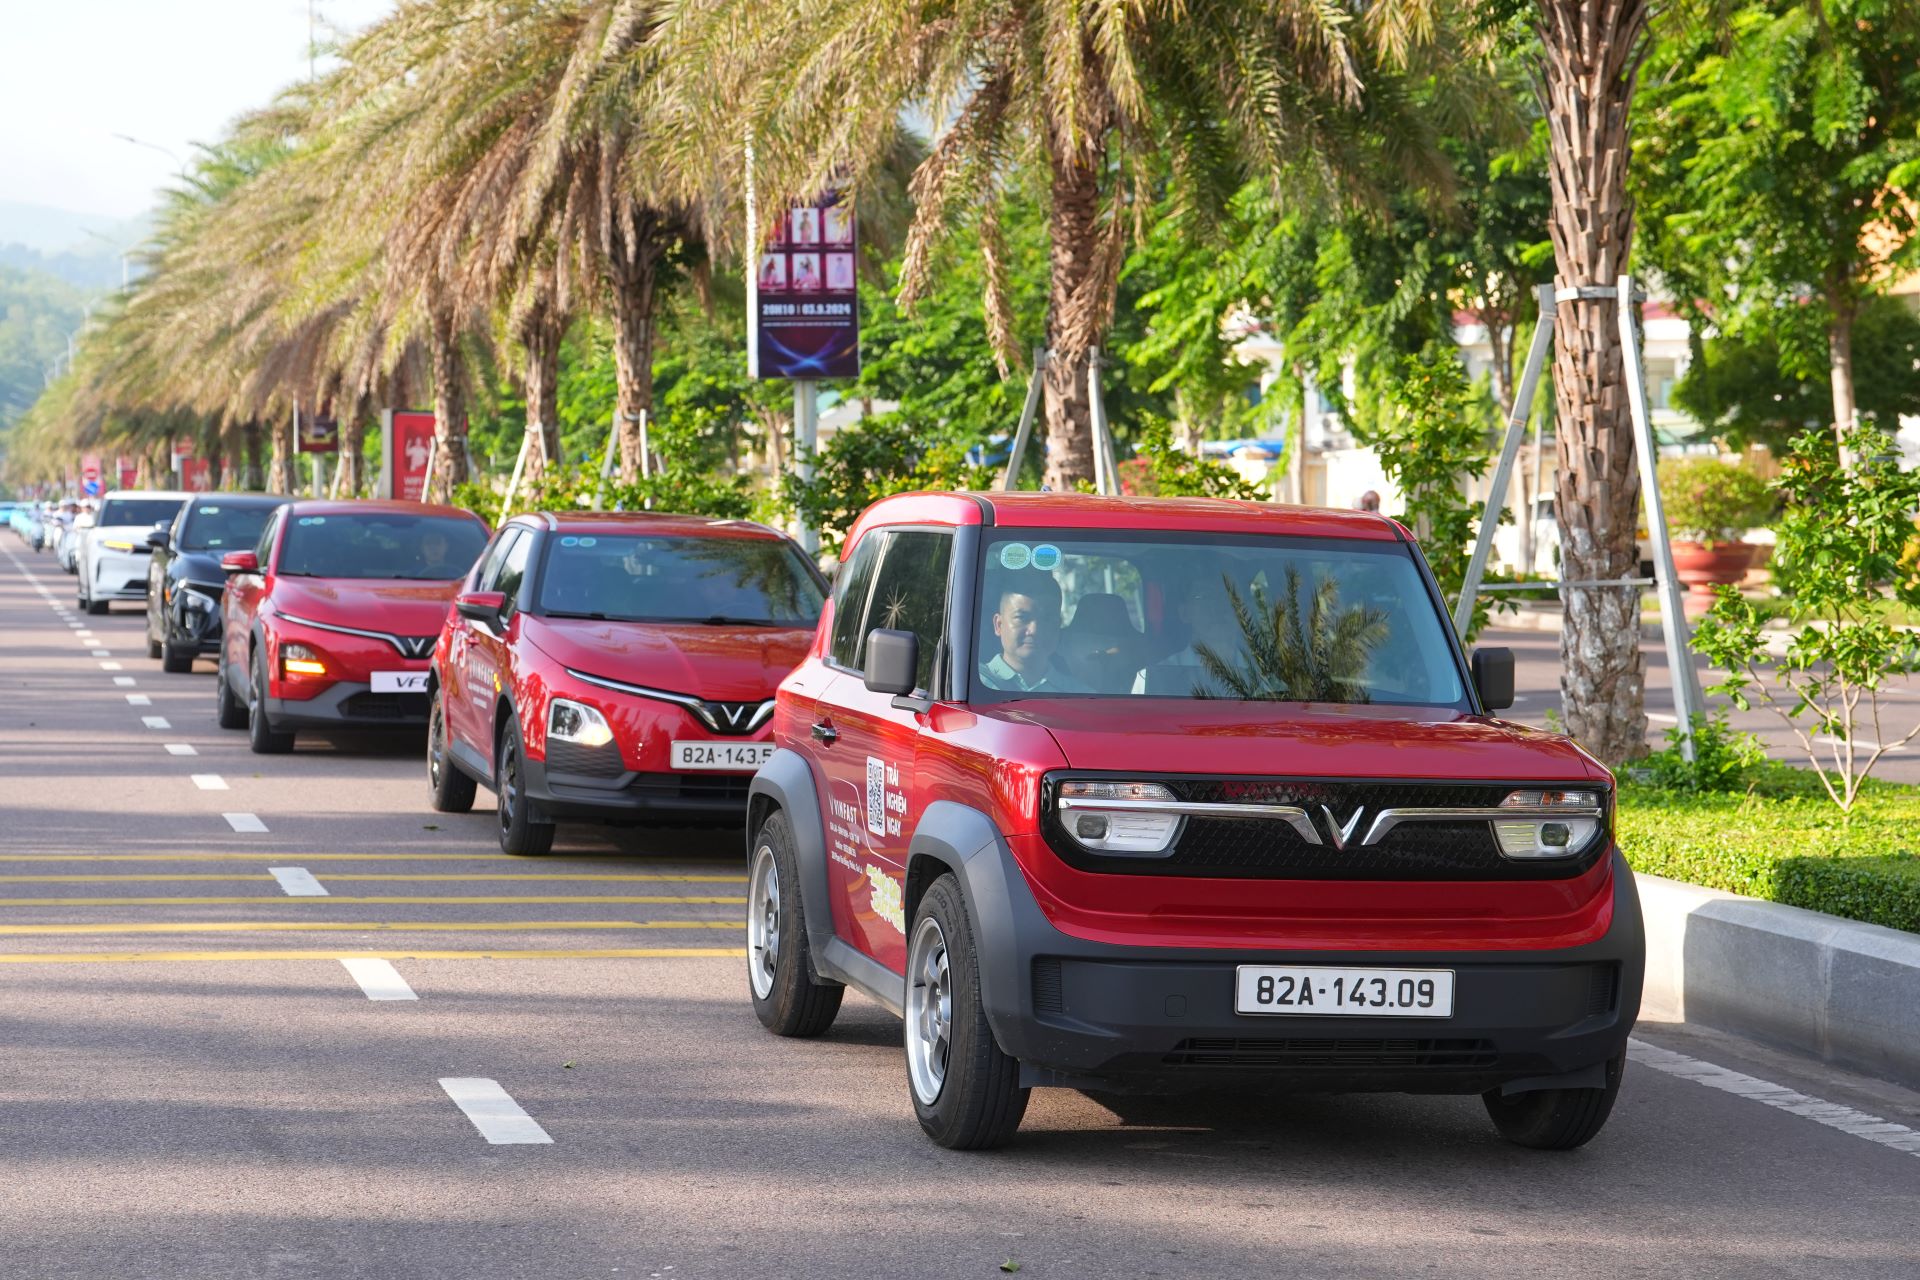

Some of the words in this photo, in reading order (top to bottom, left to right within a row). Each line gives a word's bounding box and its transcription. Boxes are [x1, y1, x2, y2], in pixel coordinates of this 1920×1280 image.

[833, 799, 857, 825] VINFAST
[886, 815, 901, 838] NGAY
[1256, 975, 1435, 1009] 82A-143.09
